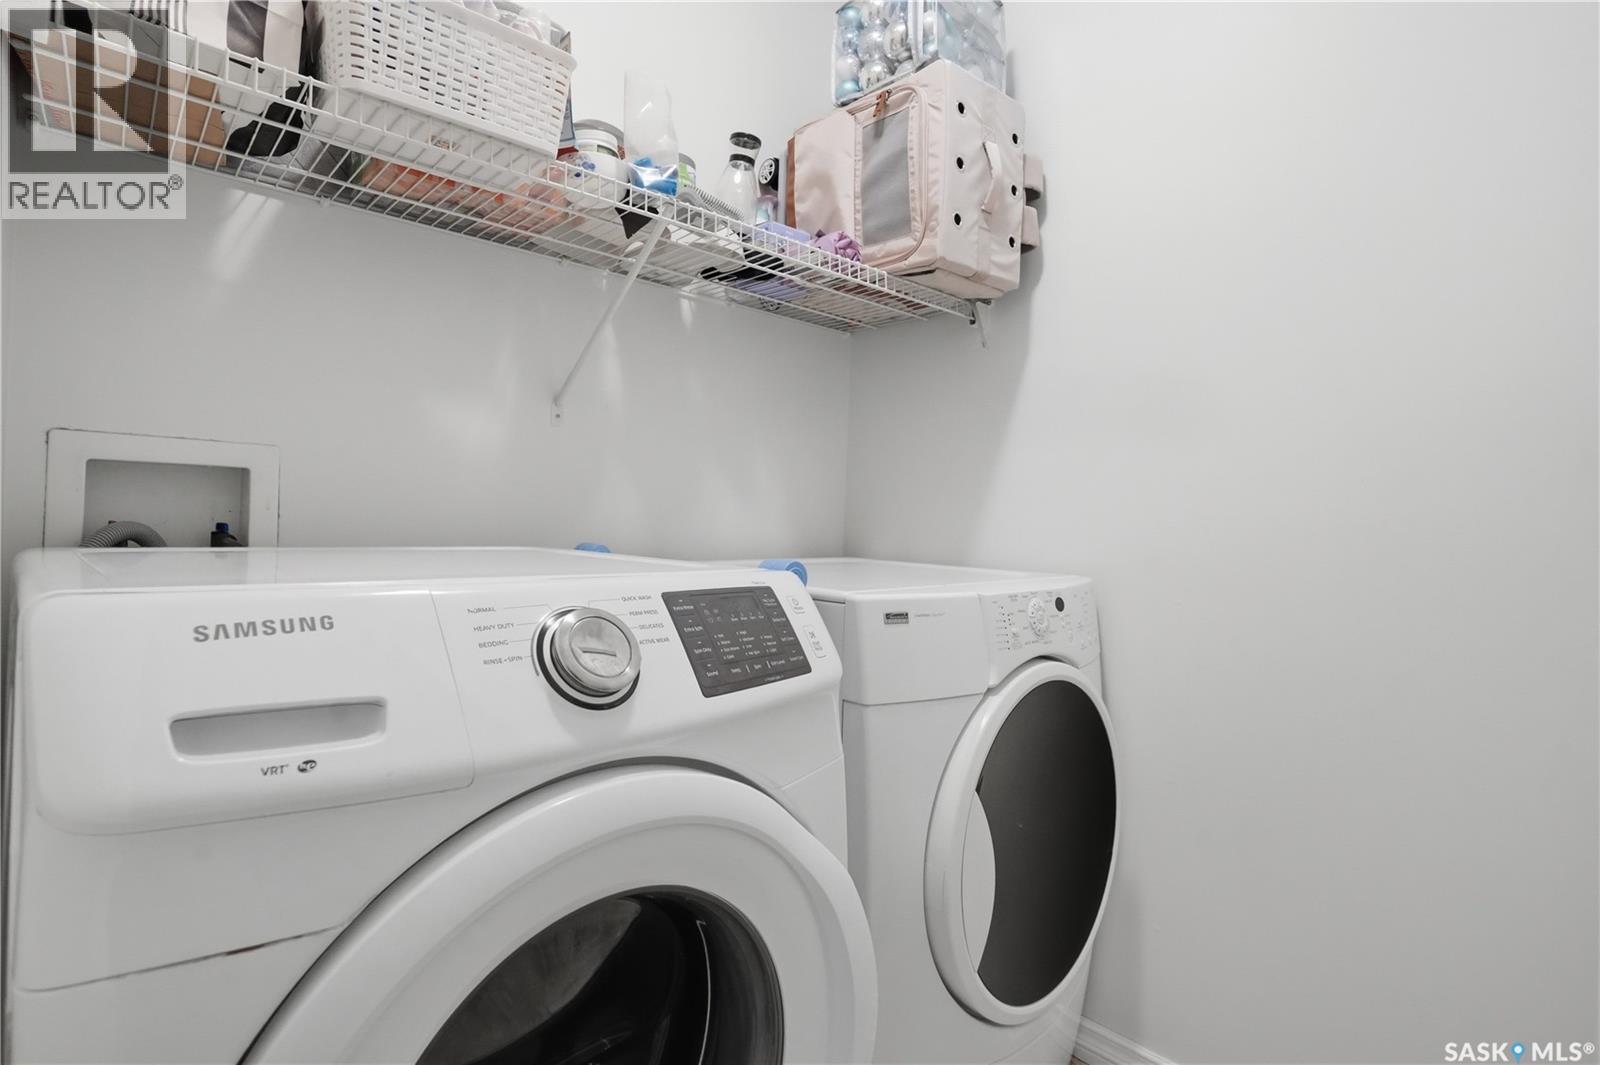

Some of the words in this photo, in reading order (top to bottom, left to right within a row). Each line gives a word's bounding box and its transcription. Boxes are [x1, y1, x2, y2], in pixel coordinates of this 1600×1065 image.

[466, 607, 496, 615] NORMAL
[193, 615, 335, 643] SAMSUNG
[473, 624, 496, 632] HEAVY
[497, 622, 514, 630] DUTY
[478, 640, 509, 649] BEDDING
